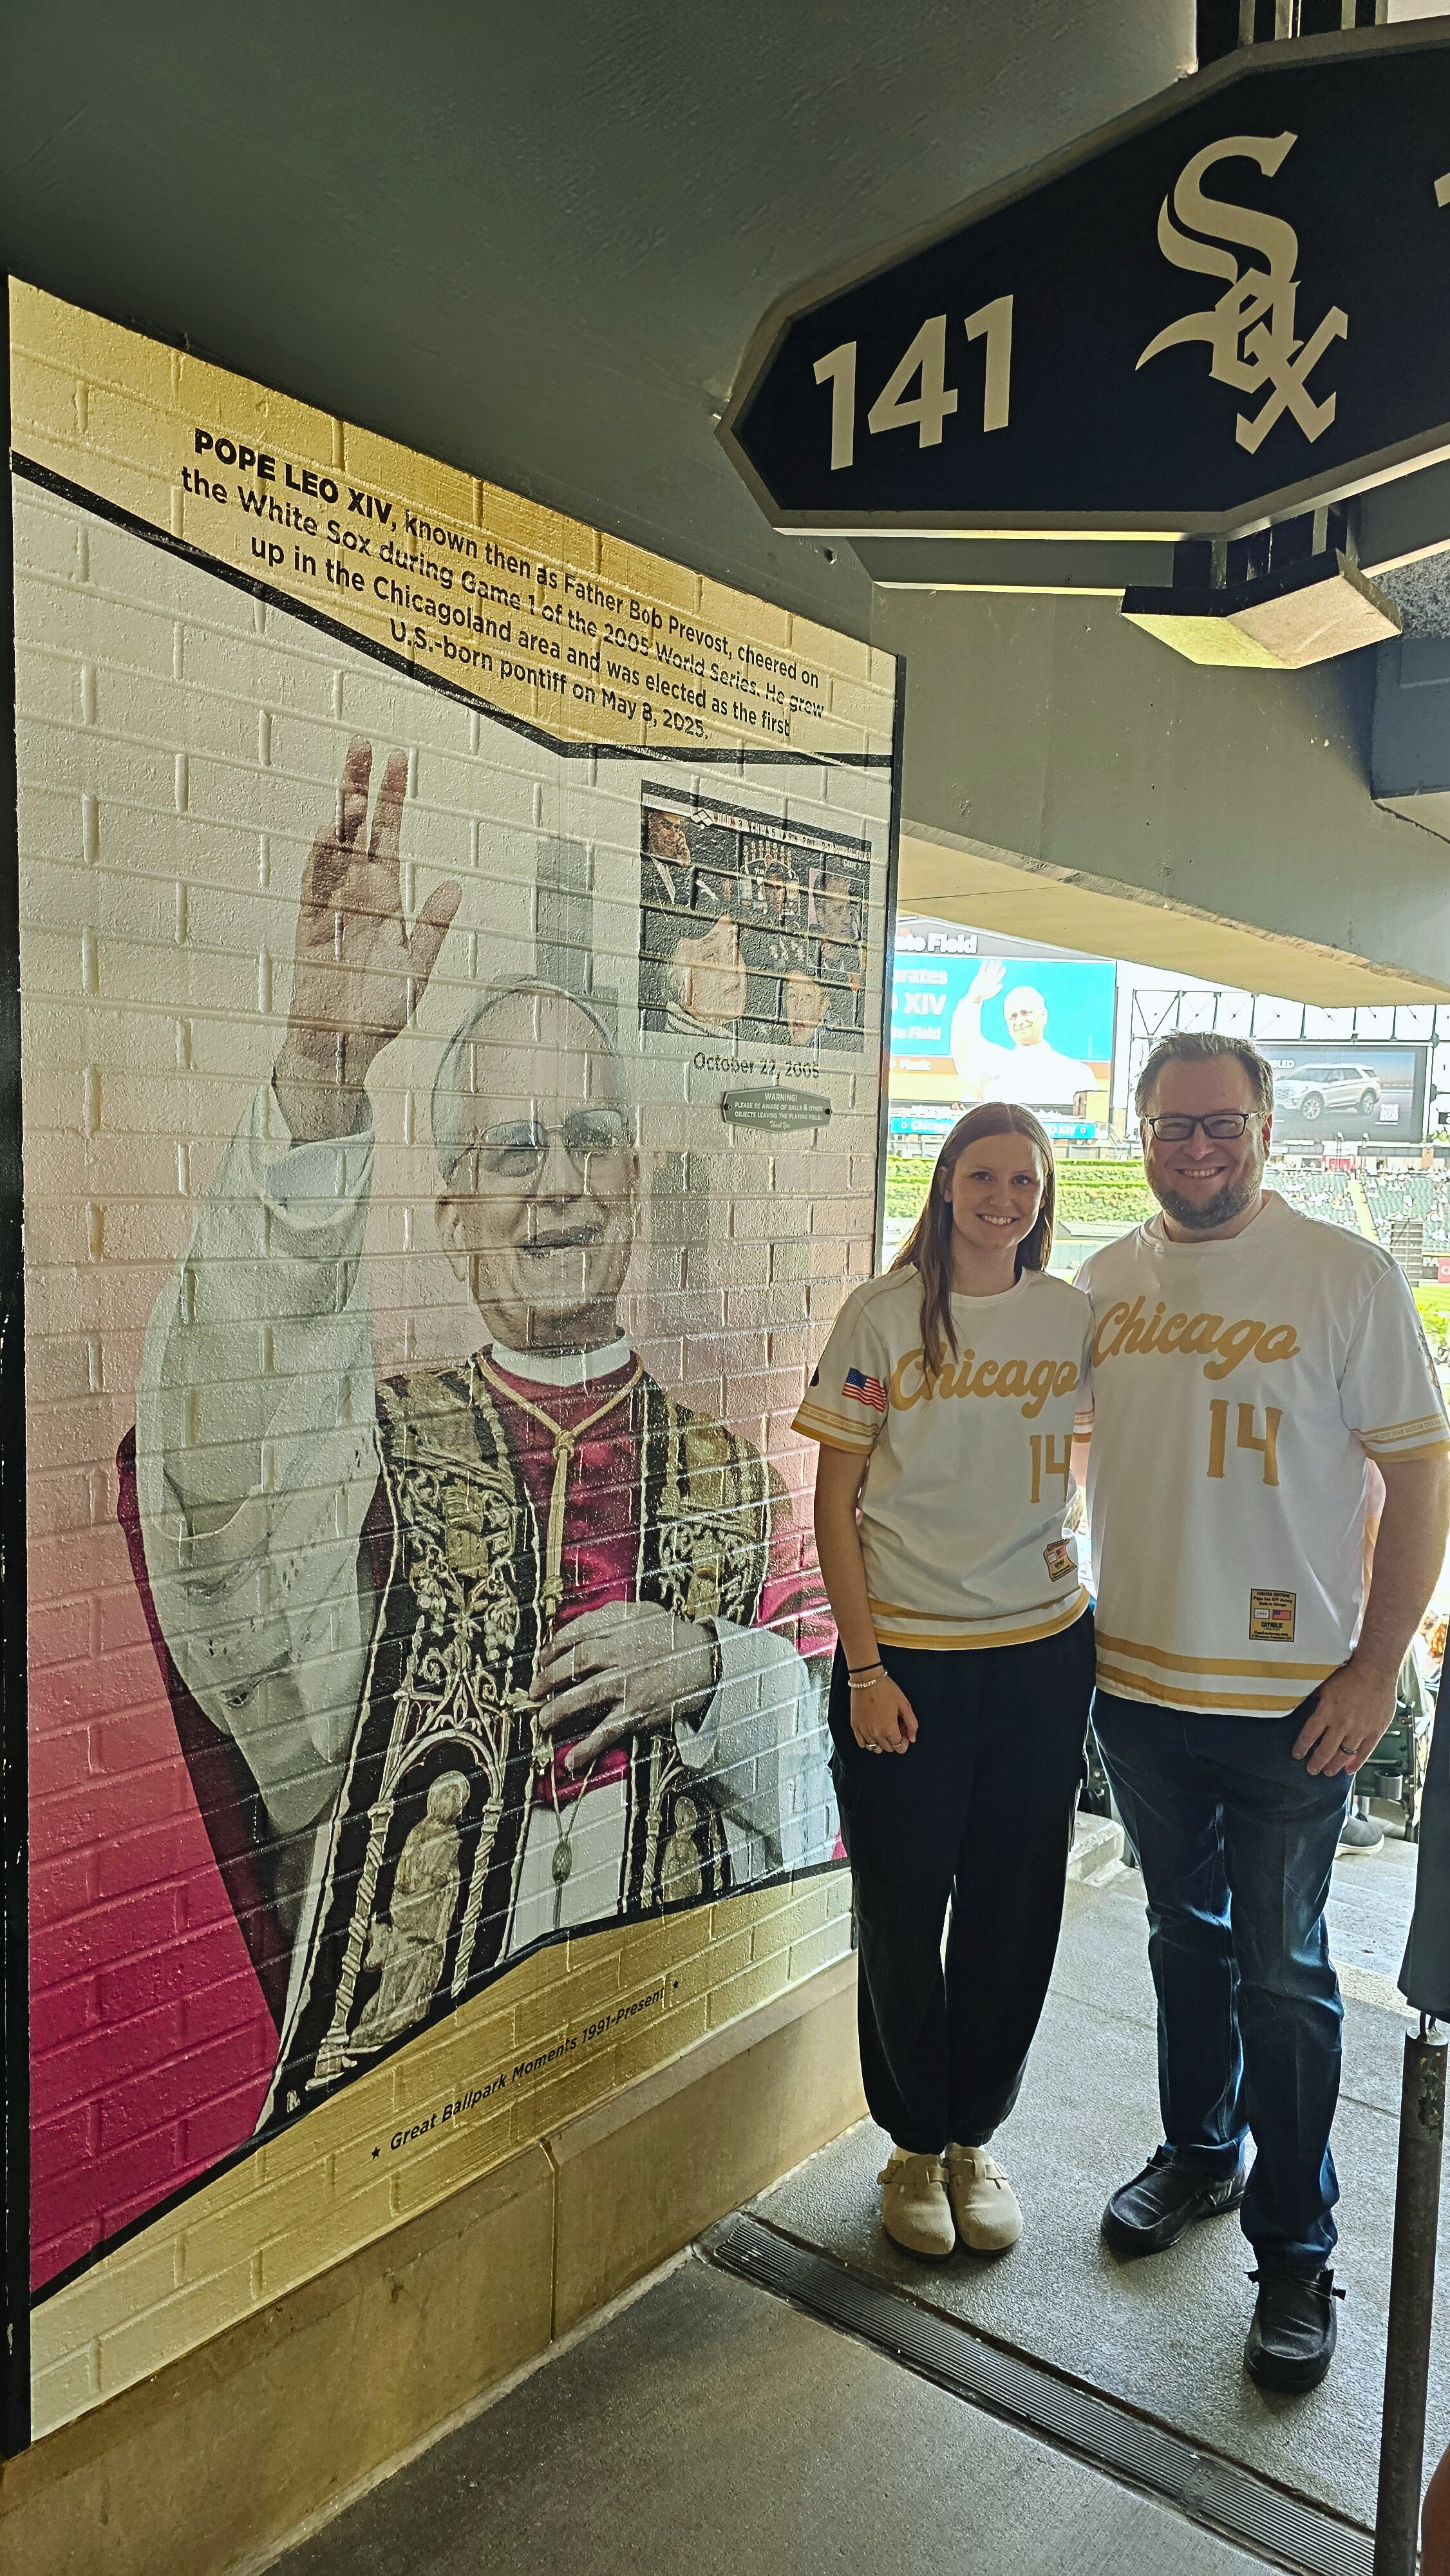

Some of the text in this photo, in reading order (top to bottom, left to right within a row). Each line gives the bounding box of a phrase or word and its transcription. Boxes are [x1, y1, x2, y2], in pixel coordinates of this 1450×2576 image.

[813, 294, 1013, 471] 141
[181, 466, 824, 719] the White Sox during Game 1 of the 2005 World Series. He grew
[194, 428, 819, 688] POPE LEO XIV, known then as Father Bob Prevost, cheered on
[252, 536, 791, 737] up in the Chicagoland area and was elected as the first
[390, 618, 493, 672] U.S.-born
[500, 659, 567, 695] pontiff
[572, 683, 595, 705] on
[602, 688, 636, 720] May
[643, 702, 657, 727] 8,
[903, 992, 948, 1016] XIV
[693, 1052, 820, 1080] October 22, 2005
[764, 1093, 798, 1102] WARNING!
[890, 1341, 1079, 1419] Chicago
[1091, 1295, 1301, 1381] Chicago
[1030, 1434, 1071, 1504] 14
[1207, 1398, 1283, 1486] 14
[390, 1987, 664, 2150] Great Ballpark Moments 1991-Present
